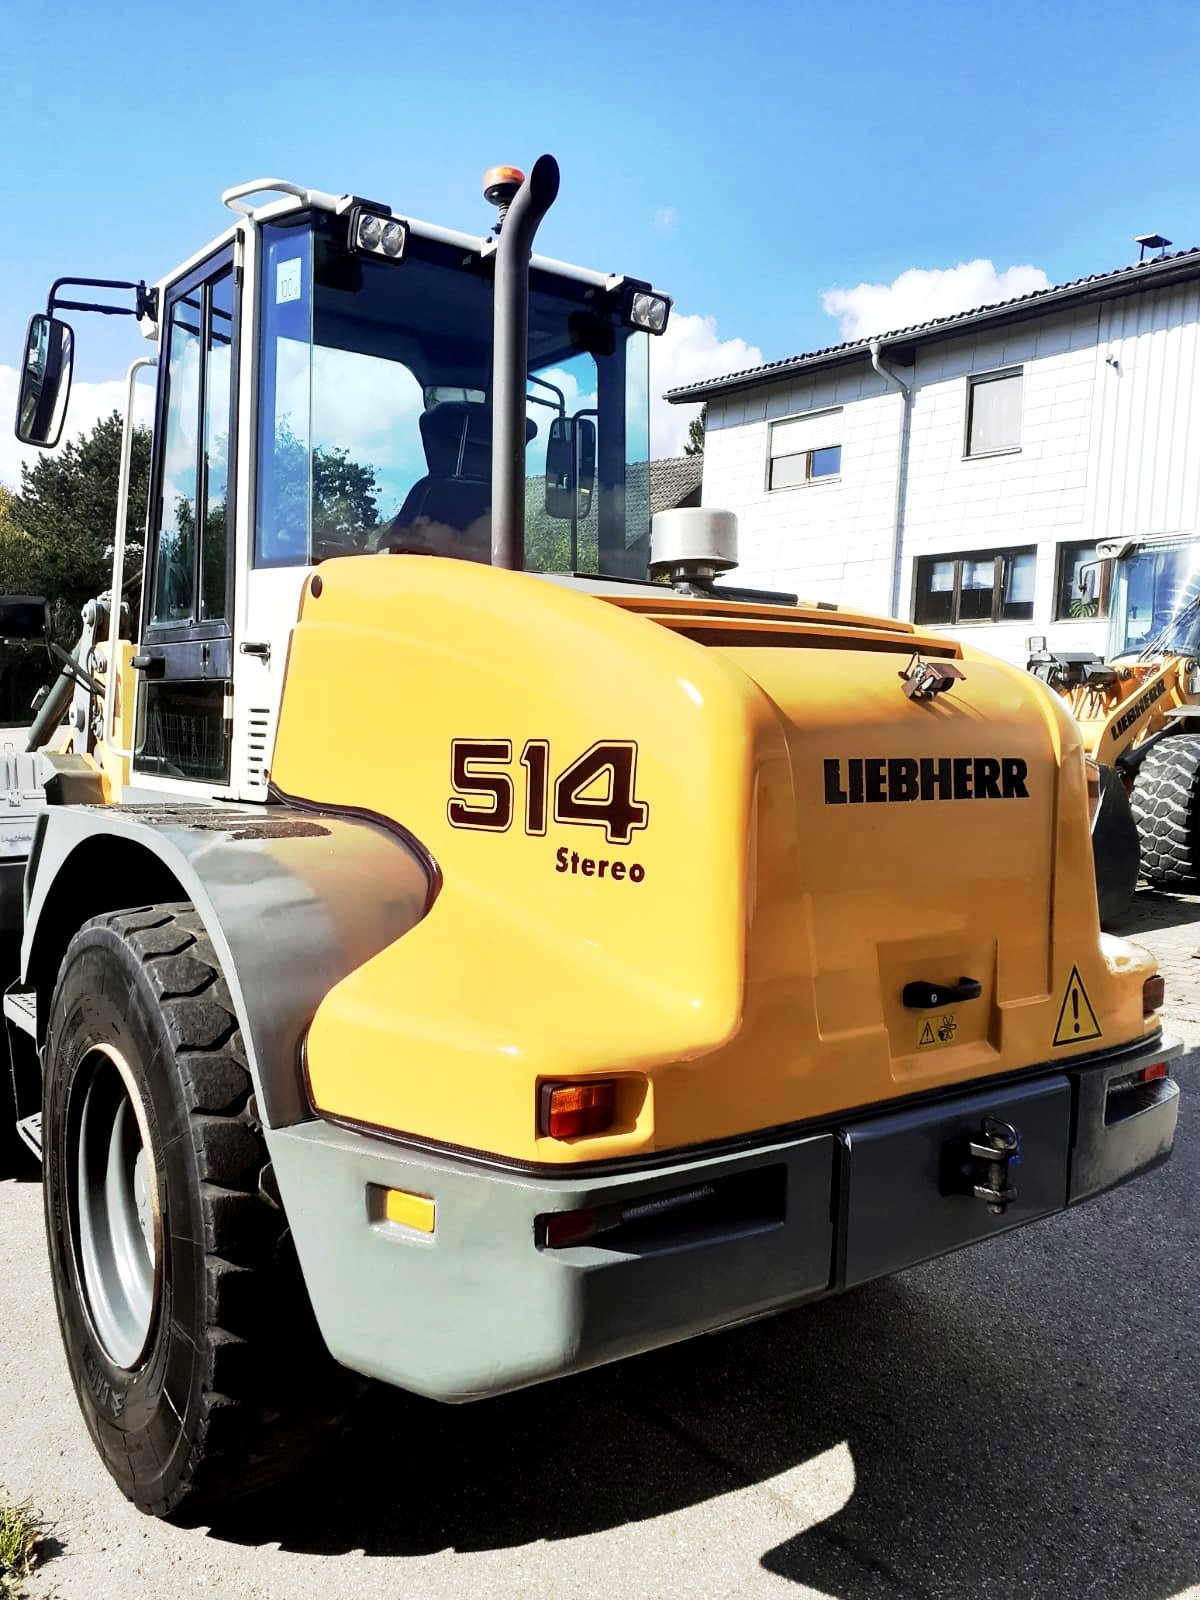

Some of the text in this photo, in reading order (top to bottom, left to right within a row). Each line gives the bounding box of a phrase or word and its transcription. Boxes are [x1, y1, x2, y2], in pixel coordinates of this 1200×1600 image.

[1110, 678, 1167, 741] LIEBHERR
[447, 738, 649, 845] 514
[823, 757, 1030, 805] LIEBHERR
[555, 846, 645, 883] Stereo
